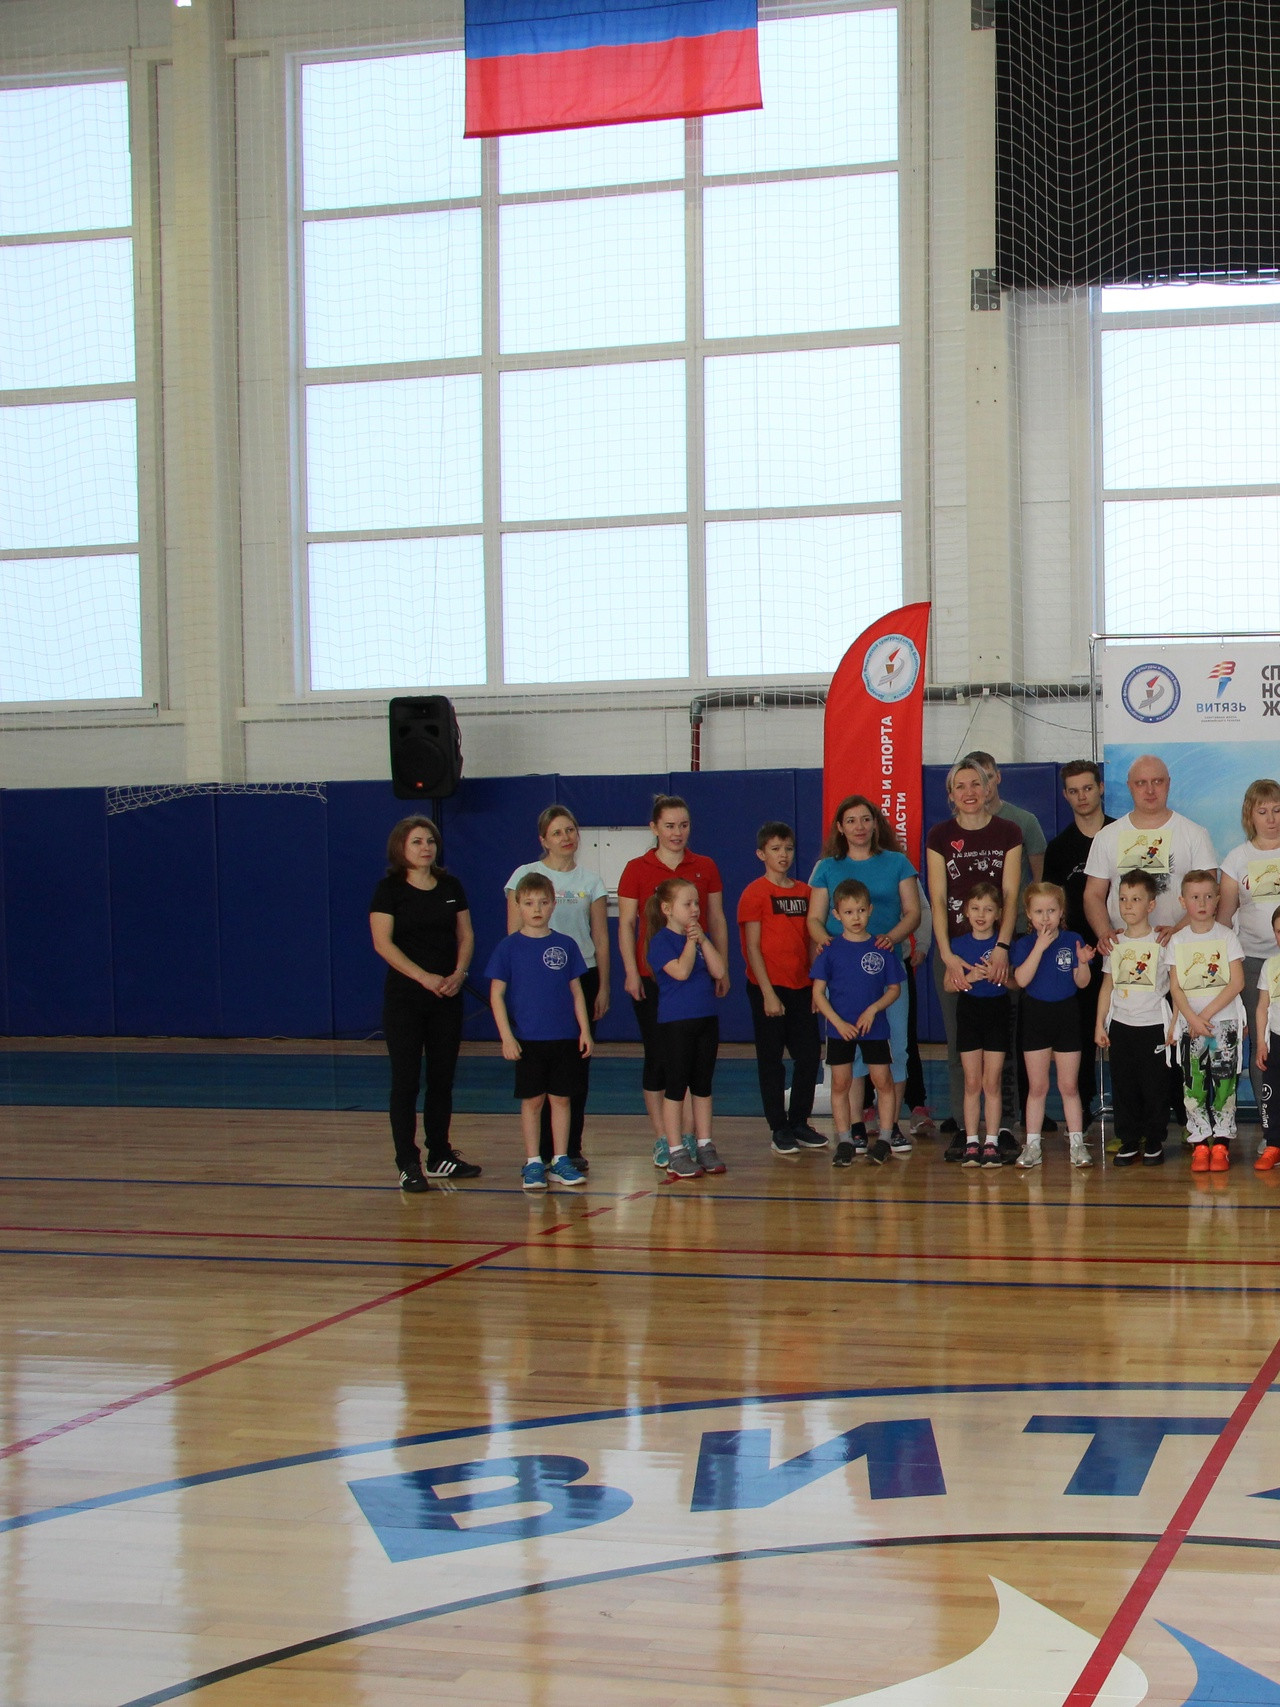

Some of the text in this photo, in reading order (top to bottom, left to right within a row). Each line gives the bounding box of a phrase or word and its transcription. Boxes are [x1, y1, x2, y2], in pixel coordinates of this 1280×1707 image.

[1196, 702, 1247, 713] ВИТЯЗЬ
[881, 716, 894, 774] СПОРТА
[882, 779, 892, 790] И
